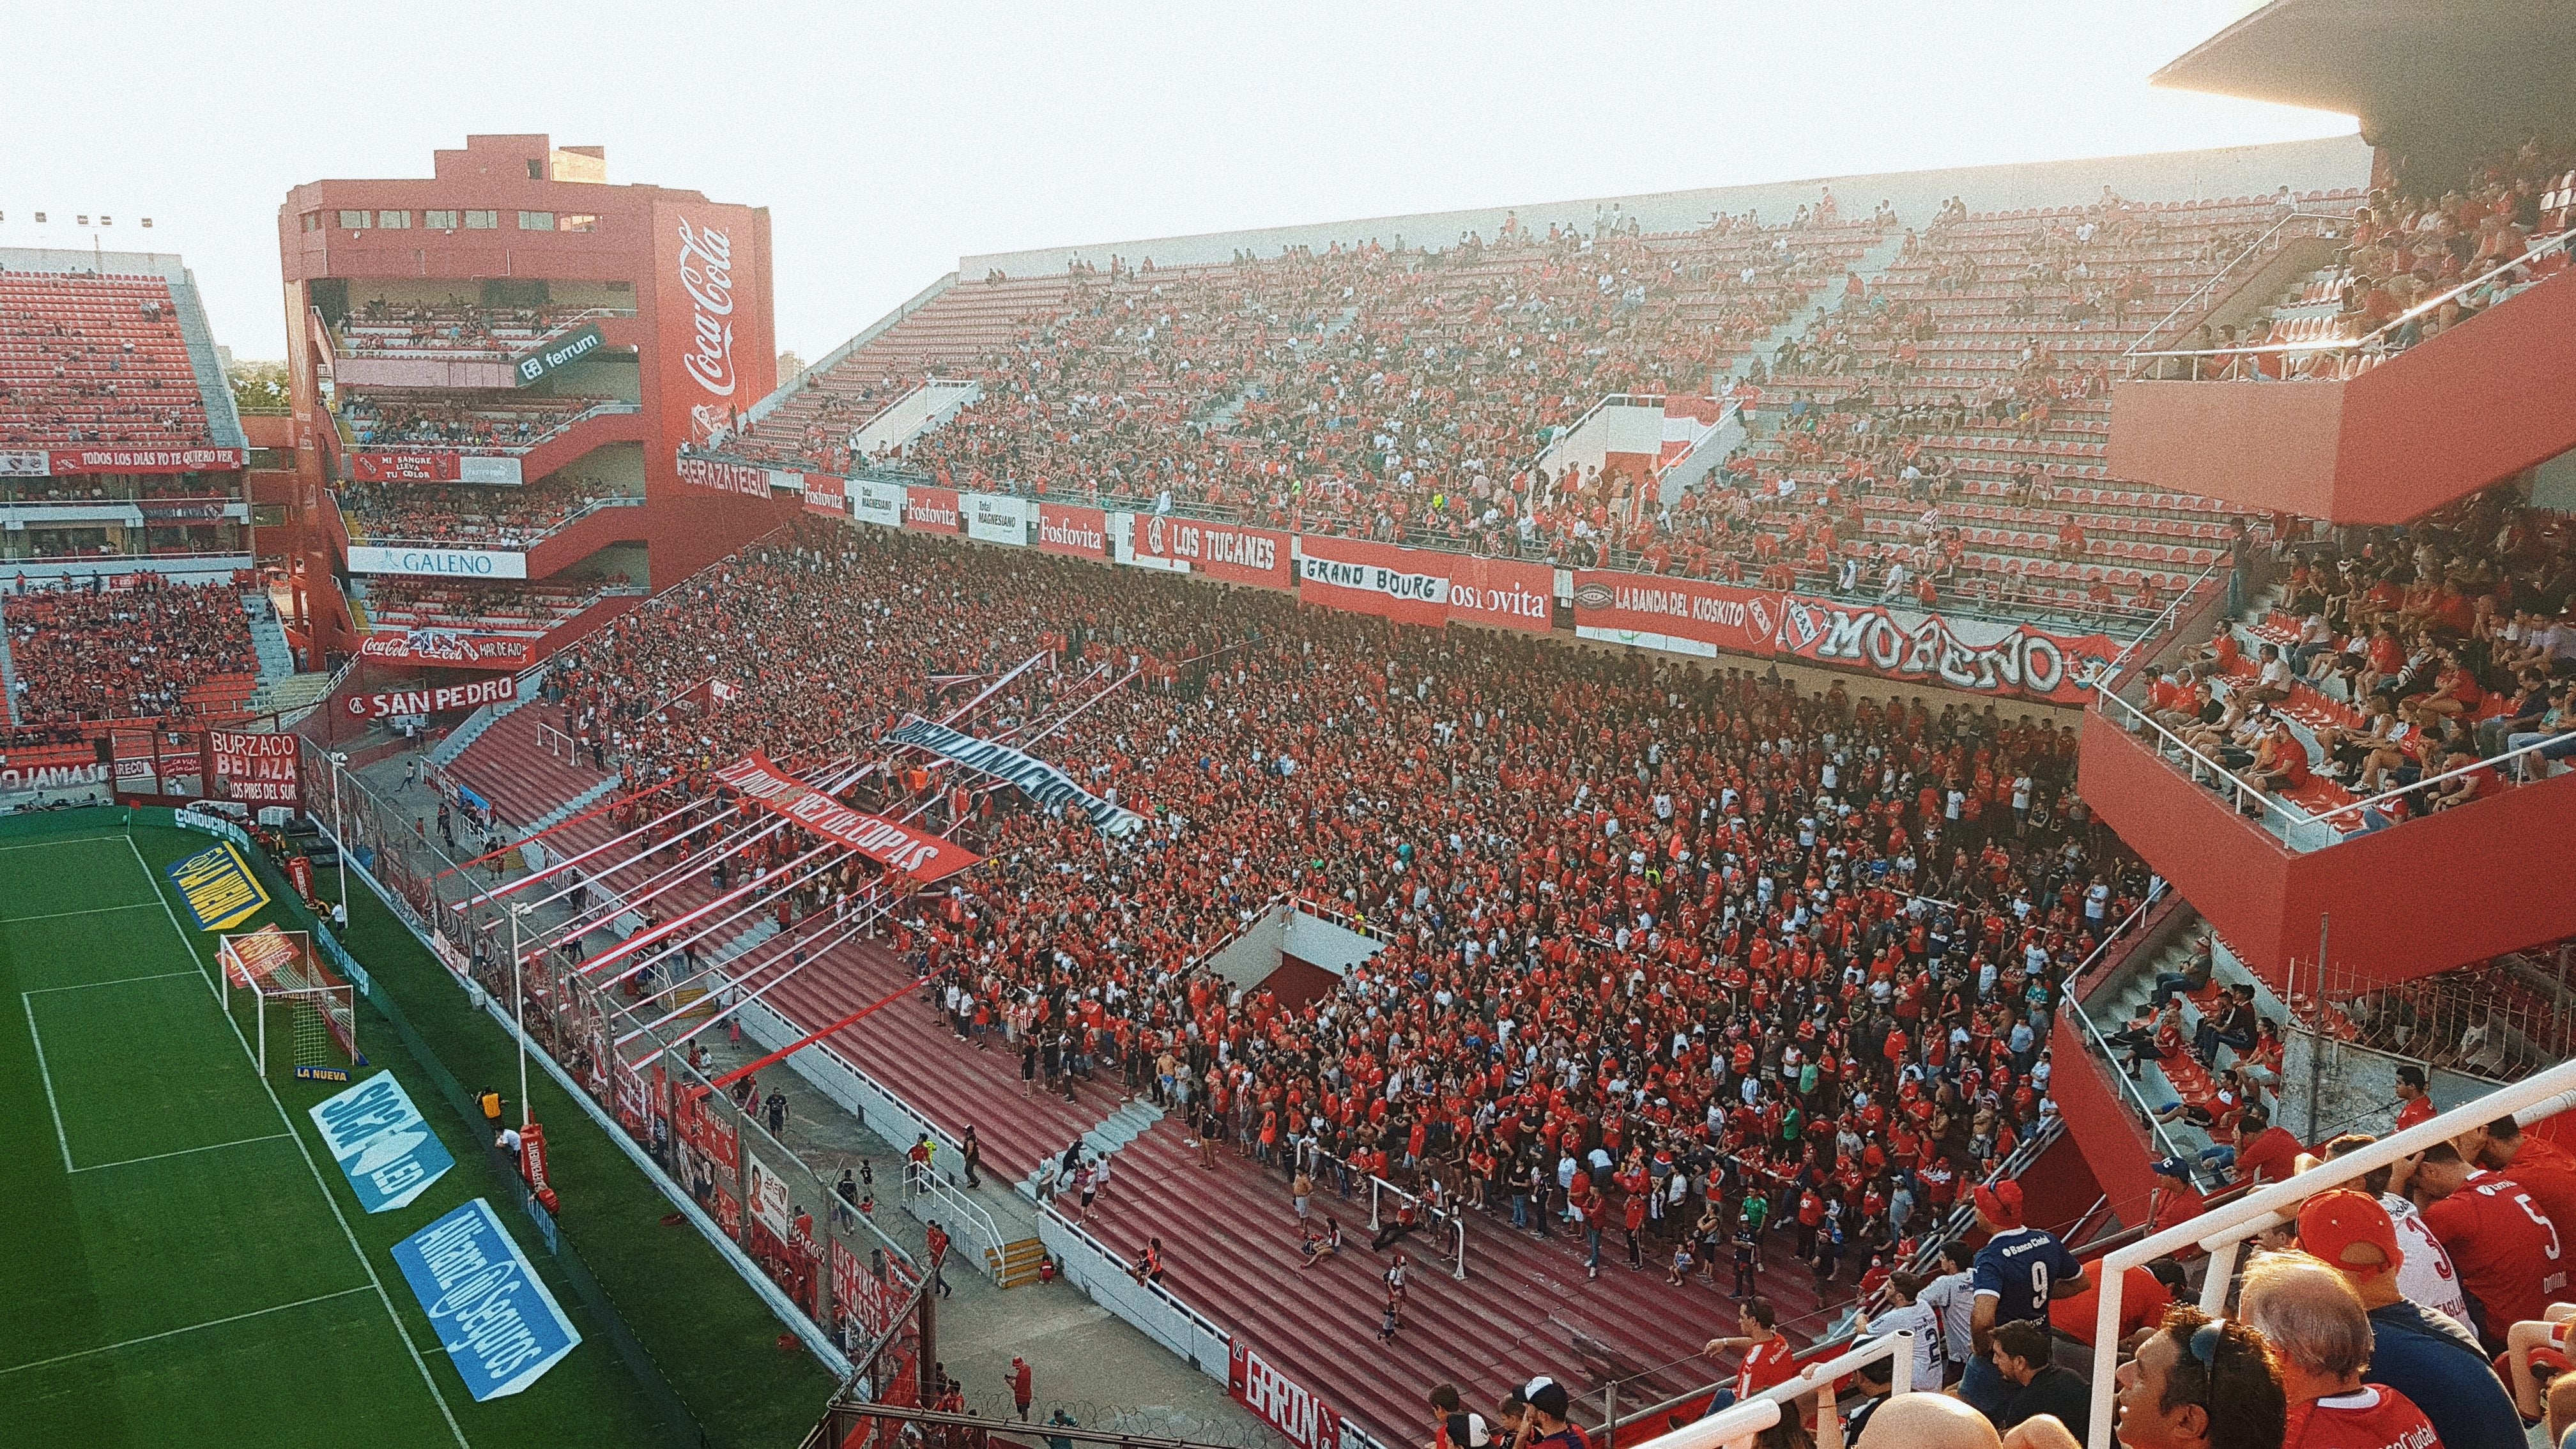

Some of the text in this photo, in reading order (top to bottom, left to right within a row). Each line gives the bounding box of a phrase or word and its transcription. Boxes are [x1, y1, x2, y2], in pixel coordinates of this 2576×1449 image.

[678, 215, 735, 396] Coca-Cola
[545, 333, 599, 368] ferrum
[82, 452, 111, 465] TODOS
[114, 451, 131, 465] LOS
[157, 450, 169, 464] YO
[172, 450, 181, 464] TE
[183, 450, 215, 464] QUIERO
[217, 450, 233, 463] VER
[385, 470, 430, 479] TU COLOR
[397, 456, 431, 464] SANGRE
[679, 459, 772, 500] BERAZATEGUI
[804, 484, 843, 510] Fosfovita
[908, 498, 956, 526] Fosfovita
[979, 501, 992, 512] Total
[978, 512, 1016, 528] MAGNESIANO
[1041, 516, 1102, 550] Fosfovita
[403, 553, 492, 574] GALENO
[1173, 524, 1199, 558] LOS
[1205, 530, 1276, 571] TUCANES
[1307, 560, 1436, 600] GRAND BOURG
[1615, 586, 1631, 611] LA
[1632, 587, 1668, 614] BANDA
[1669, 591, 1689, 618] DEL
[1692, 595, 1745, 627] KIOSKITO
[480, 641, 496, 657] MAR
[497, 643, 507, 657] DE
[372, 676, 513, 717] SAN PEDRO
[210, 731, 295, 756] BURZACO
[230, 782, 297, 801] LOS PIBES DEL SUR
[174, 808, 227, 834] CONDUCIR
[786, 792, 845, 824] REY
[845, 818, 940, 872] COPAS
[297, 1068, 347, 1082] LA NUEVA
[371, 1154, 426, 1195] LED
[2161, 1157, 2174, 1169] C
[2514, 1193, 2561, 1260] 5
[414, 1209, 488, 1291] Allianz
[2010, 1241, 2033, 1256] Banco
[832, 1236, 850, 1278] LOS
[853, 1258, 882, 1310] PIBES
[832, 1265, 849, 1307] DEL
[2030, 1261, 2049, 1310] 9
[446, 1280, 542, 1379] Seguros
[1244, 1349, 1319, 1449] GARIN
[2399, 1418, 2438, 1449] Ciudad
